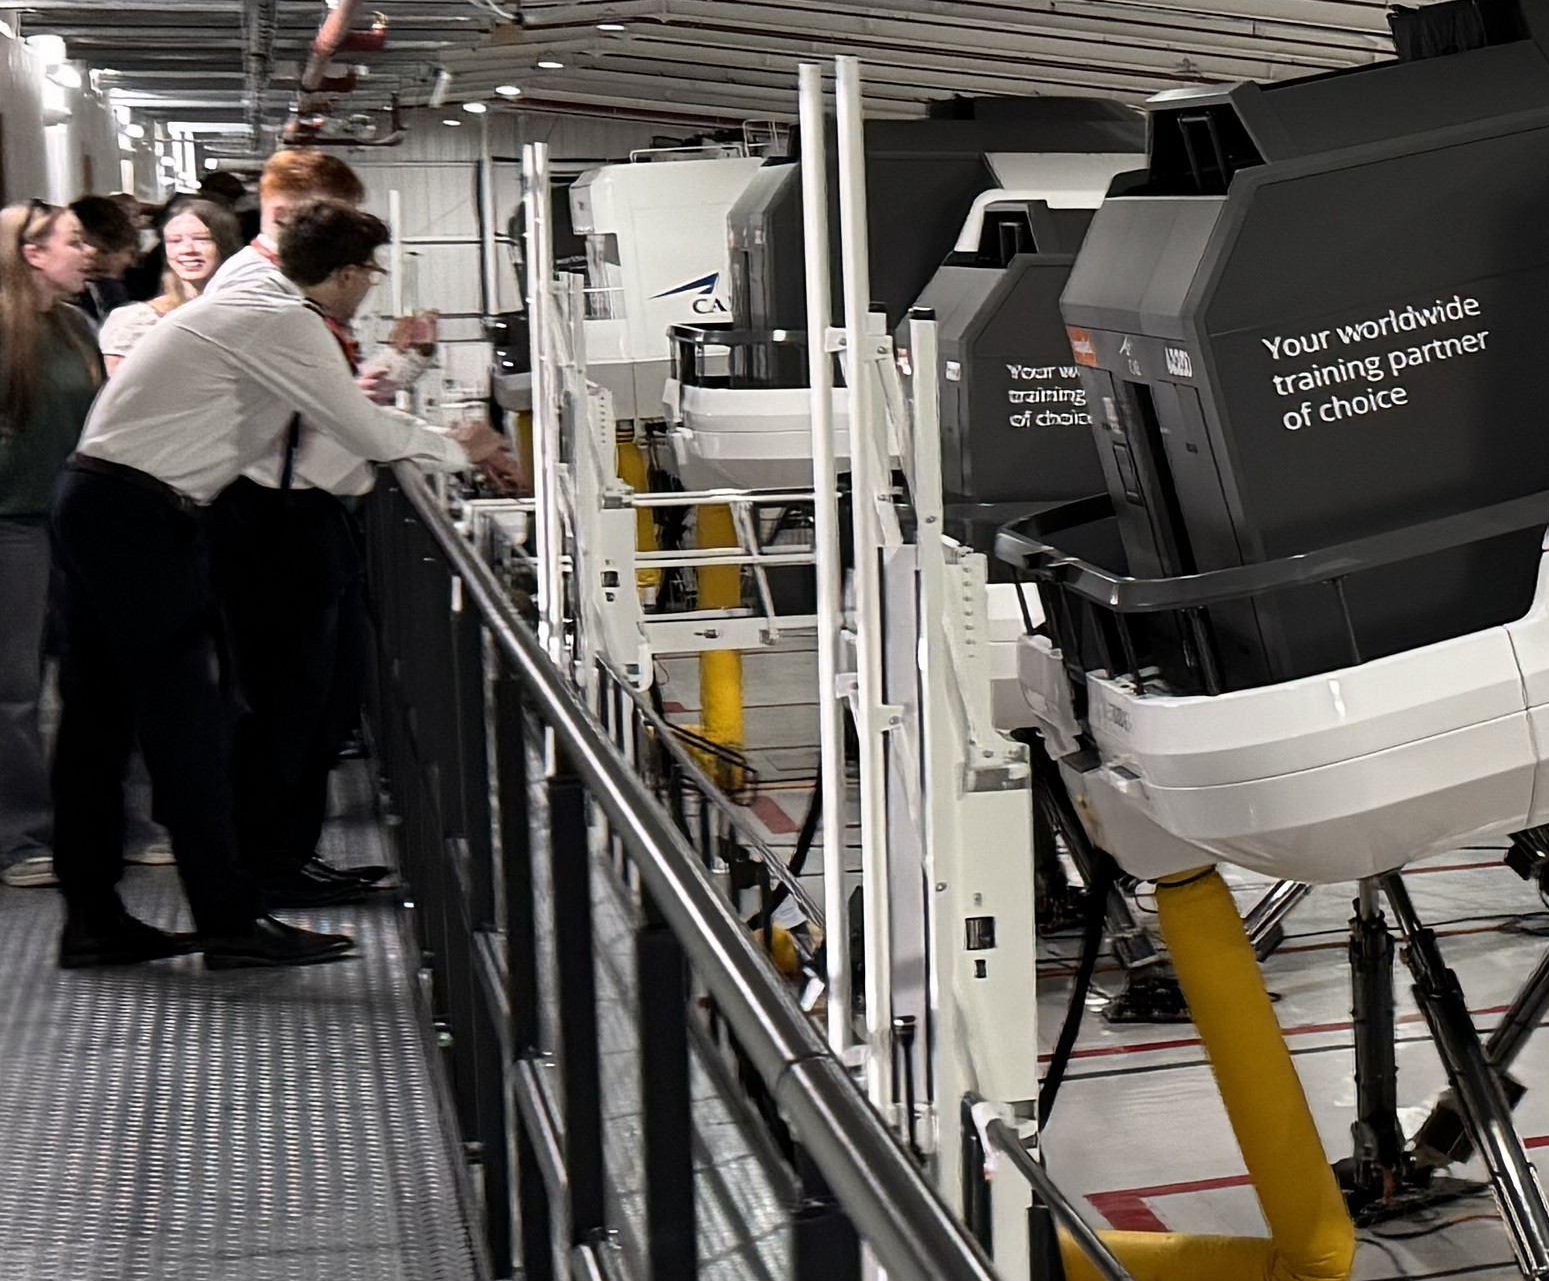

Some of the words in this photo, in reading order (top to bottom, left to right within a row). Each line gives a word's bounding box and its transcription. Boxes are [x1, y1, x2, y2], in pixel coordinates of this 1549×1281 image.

[692, 297, 731, 315] CA
[1261, 329, 1331, 360] Your
[1336, 294, 1482, 345] worldwide
[1006, 364, 1056, 379] Your
[1272, 355, 1385, 396] training
[1387, 330, 1490, 377] partner
[1282, 401, 1313, 431] of
[1318, 387, 1409, 423] choice
